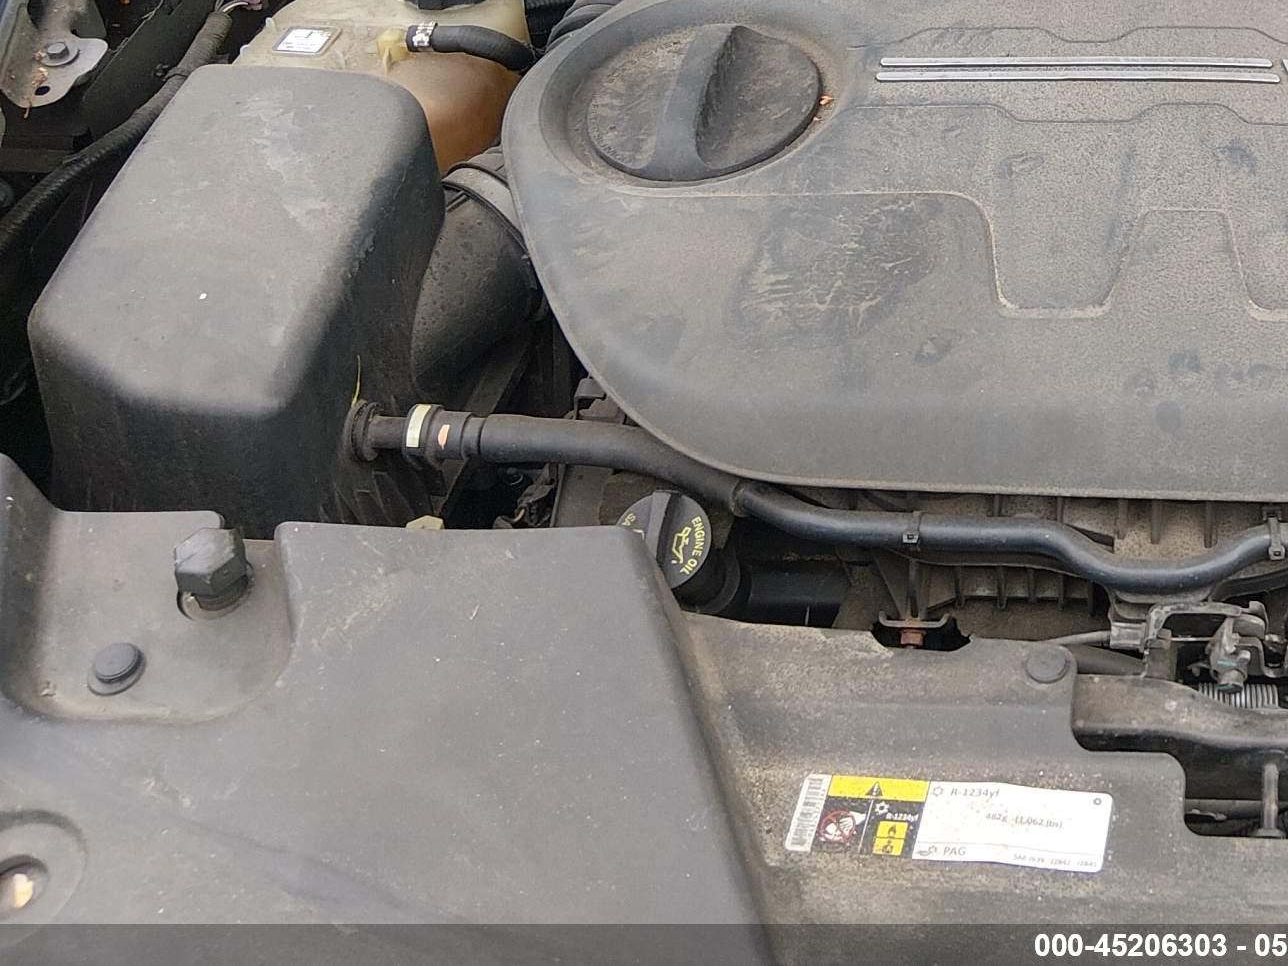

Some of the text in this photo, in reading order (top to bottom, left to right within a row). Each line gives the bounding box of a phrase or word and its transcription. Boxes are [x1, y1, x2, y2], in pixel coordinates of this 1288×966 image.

[679, 516, 705, 575] ENGINE OIL
[943, 845, 968, 857] PAG
